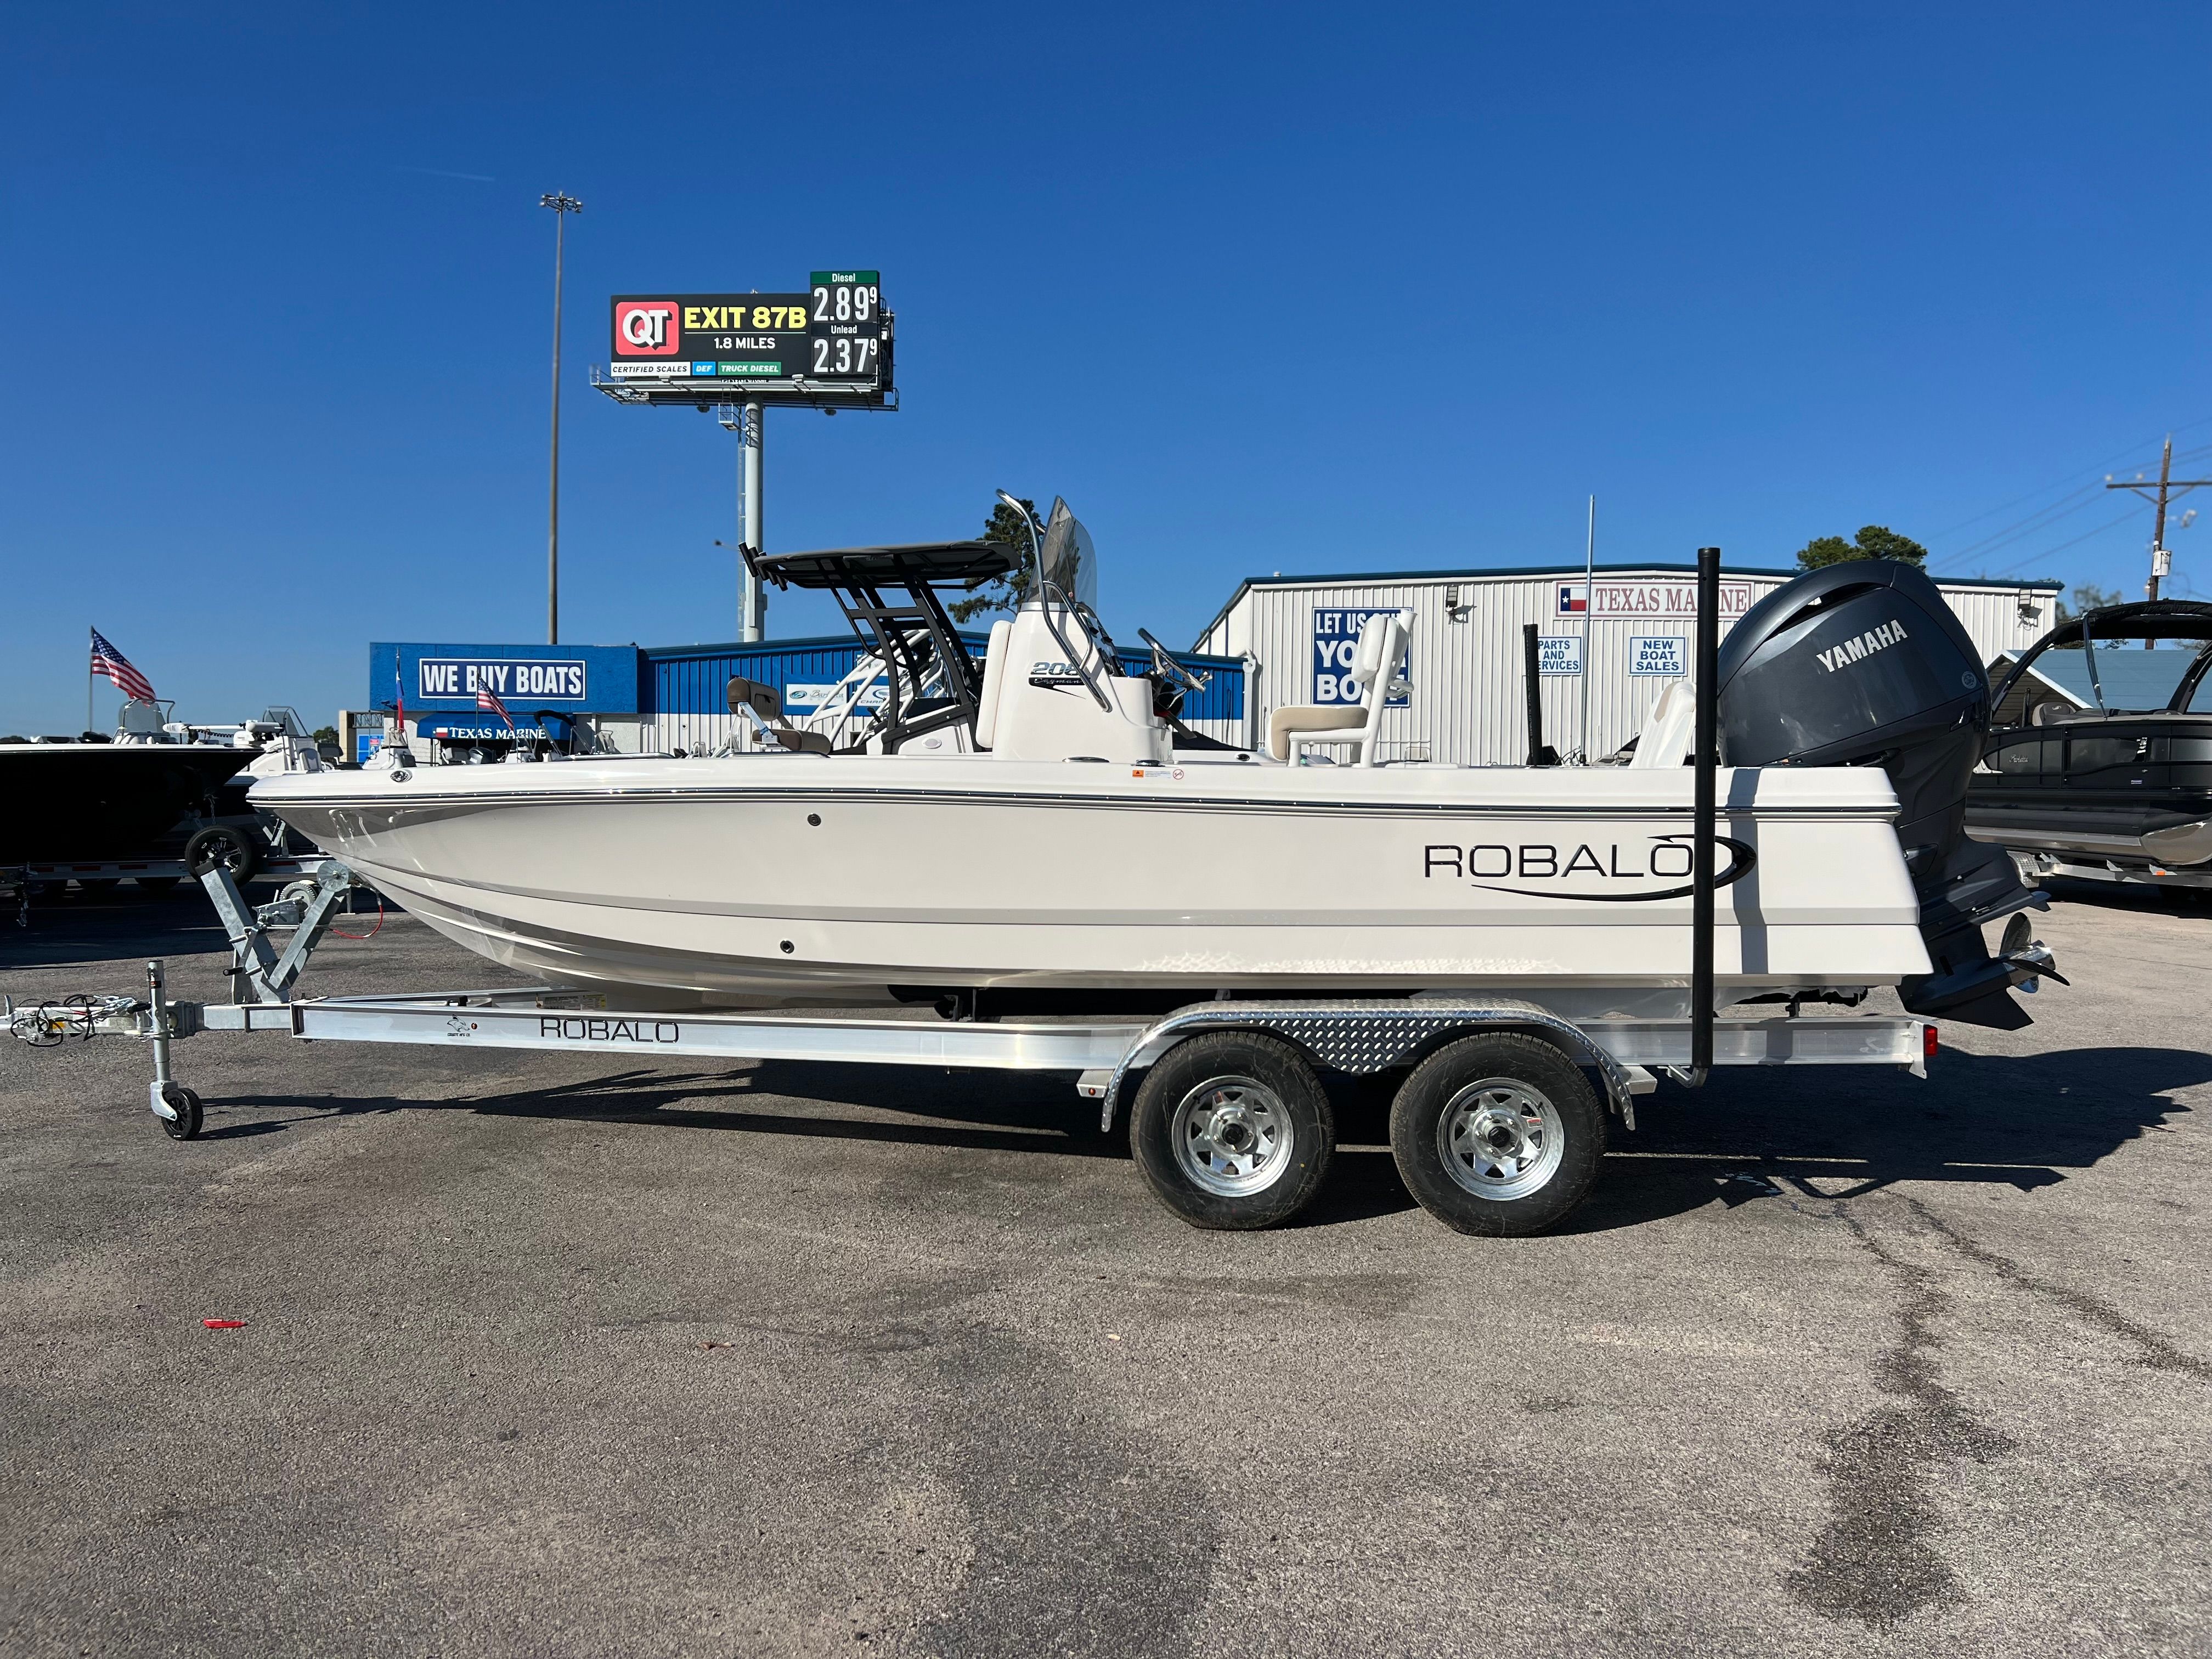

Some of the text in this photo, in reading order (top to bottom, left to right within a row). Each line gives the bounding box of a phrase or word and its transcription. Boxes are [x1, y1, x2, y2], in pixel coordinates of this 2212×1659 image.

[832, 273, 856, 282] Diesel
[685, 306, 806, 329] EXIT 87B
[622, 309, 672, 349] QT
[831, 325, 857, 334] Unlead
[714, 337, 776, 349] 1.8 MILES
[1595, 588, 1747, 612] TEXAS MANE
[1316, 613, 1367, 634] LET US
[1538, 640, 1570, 650] PARTS
[1643, 640, 1673, 649] NEW
[1816, 619, 1908, 672] YAMAHA
[1543, 651, 1565, 659] AND
[1640, 651, 1675, 660] BOAT
[1538, 661, 1579, 669] ERVICES
[1636, 662, 1679, 671] SALES
[423, 665, 582, 694] WE BUY BOATS
[449, 727, 492, 738] TEXAS
[1425, 844, 1694, 877] ROBALO
[540, 1017, 679, 1043] ROBALO
